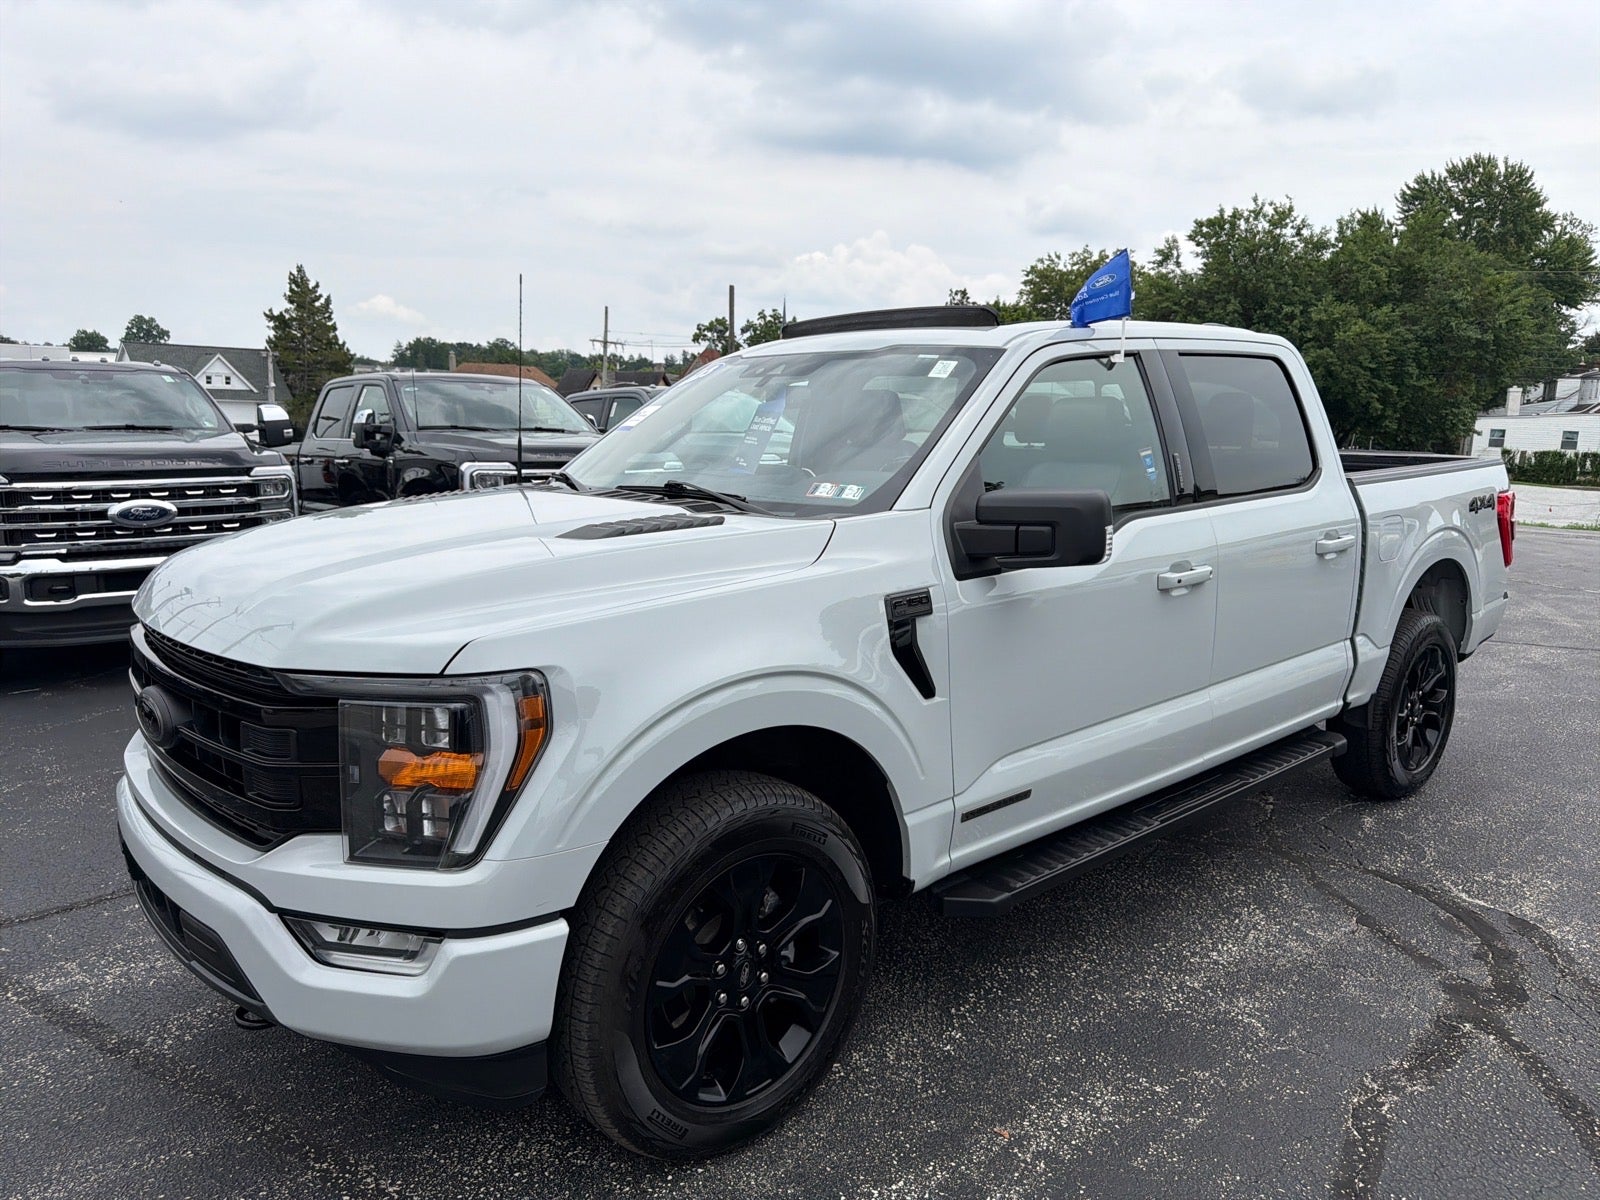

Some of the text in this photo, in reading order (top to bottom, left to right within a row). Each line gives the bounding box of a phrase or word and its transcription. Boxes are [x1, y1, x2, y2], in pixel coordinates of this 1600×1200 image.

[43, 457, 222, 469] SUPER DUTY
[128, 506, 160, 520] Ford
[892, 594, 930, 610] F-150
[791, 822, 829, 846] PIRELLI
[646, 1108, 690, 1140] PIRELLI
